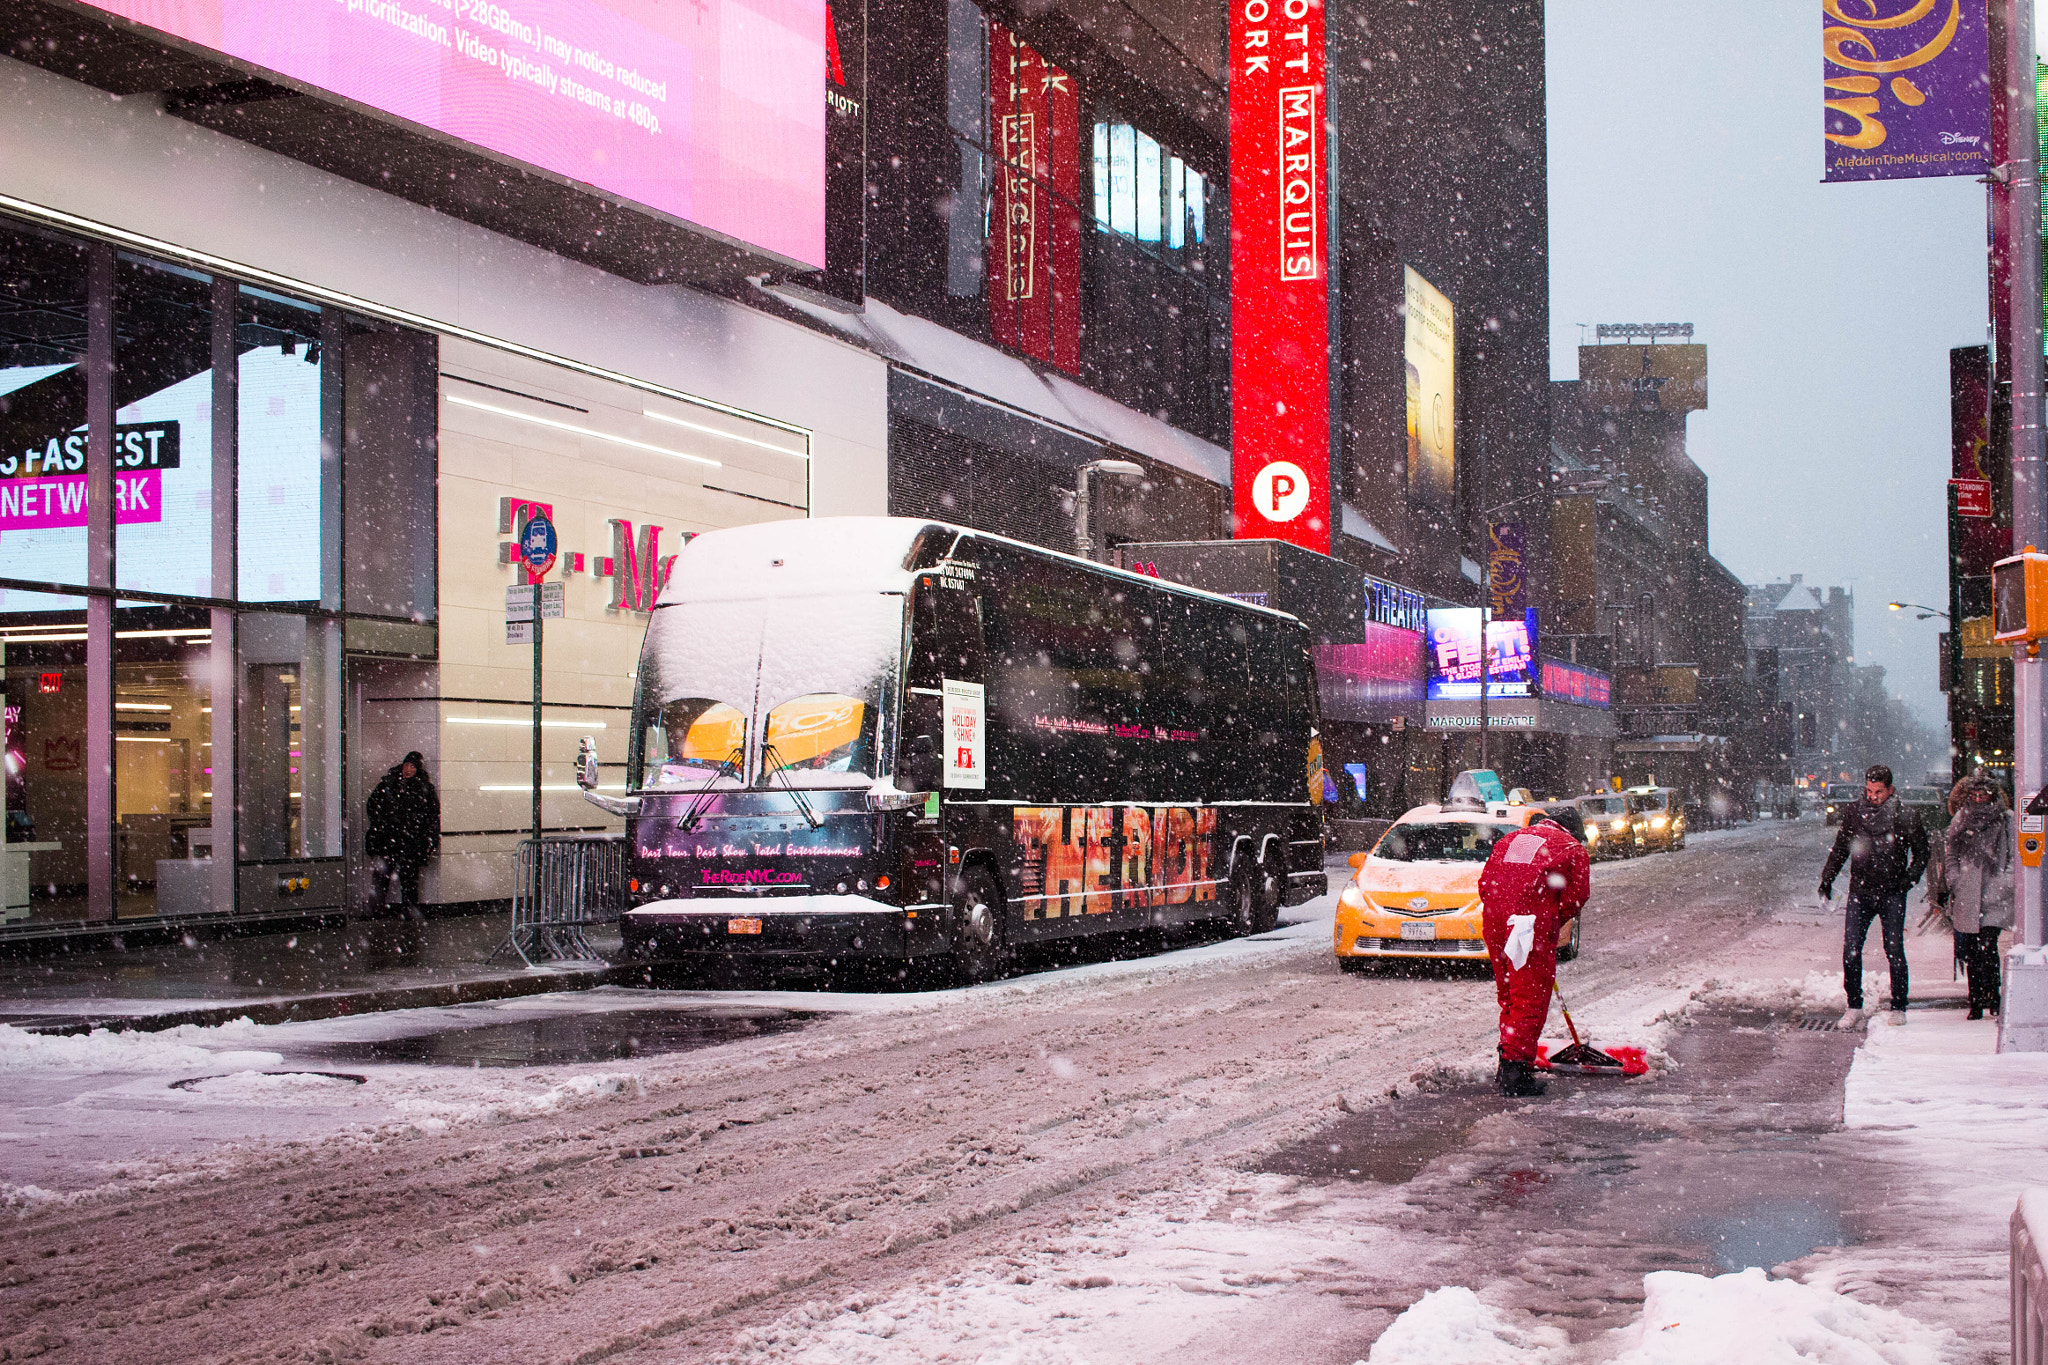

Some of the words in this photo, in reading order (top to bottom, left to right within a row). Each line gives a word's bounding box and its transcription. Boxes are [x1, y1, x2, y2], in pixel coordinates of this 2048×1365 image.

[544, 35, 571, 65] may
[575, 48, 614, 79] notice
[617, 66, 667, 102] reduced
[455, 27, 498, 65] Video
[500, 49, 558, 94] typically
[560, 77, 611, 113] streams
[614, 99, 626, 119] at
[628, 101, 662, 135] 480p.
[825, 90, 860, 117] RIOTT
[1938, 132, 1981, 147] Disney
[1836, 151, 1981, 167] AladdinTheMusical.com
[1286, 94, 1311, 275] MARQUIS
[1, 477, 150, 518] NETWRK
[1272, 475, 1295, 511] P
[1372, 580, 1425, 633] THEATRE
[1440, 666, 1458, 676] THE
[1459, 661, 1483, 673] STOR
[1501, 654, 1532, 667] EMILIO
[1455, 669, 1482, 680] GLORI
[1488, 660, 1527, 675] ESTEFAN
[42, 673, 62, 692] EXIT
[952, 714, 977, 729] HOLIDAY
[1430, 716, 1482, 728] MARQUIS
[1487, 716, 1535, 726] THEATRE
[957, 727, 972, 743] SHINE
[641, 845, 661, 858] Part
[667, 845, 690, 857] Tour.
[696, 845, 717, 858] Part
[722, 844, 748, 857] Show.
[755, 843, 781, 856] Total
[786, 843, 863, 857] Entertainment.
[1013, 807, 1114, 921] THE
[1121, 807, 1218, 909] RIDE
